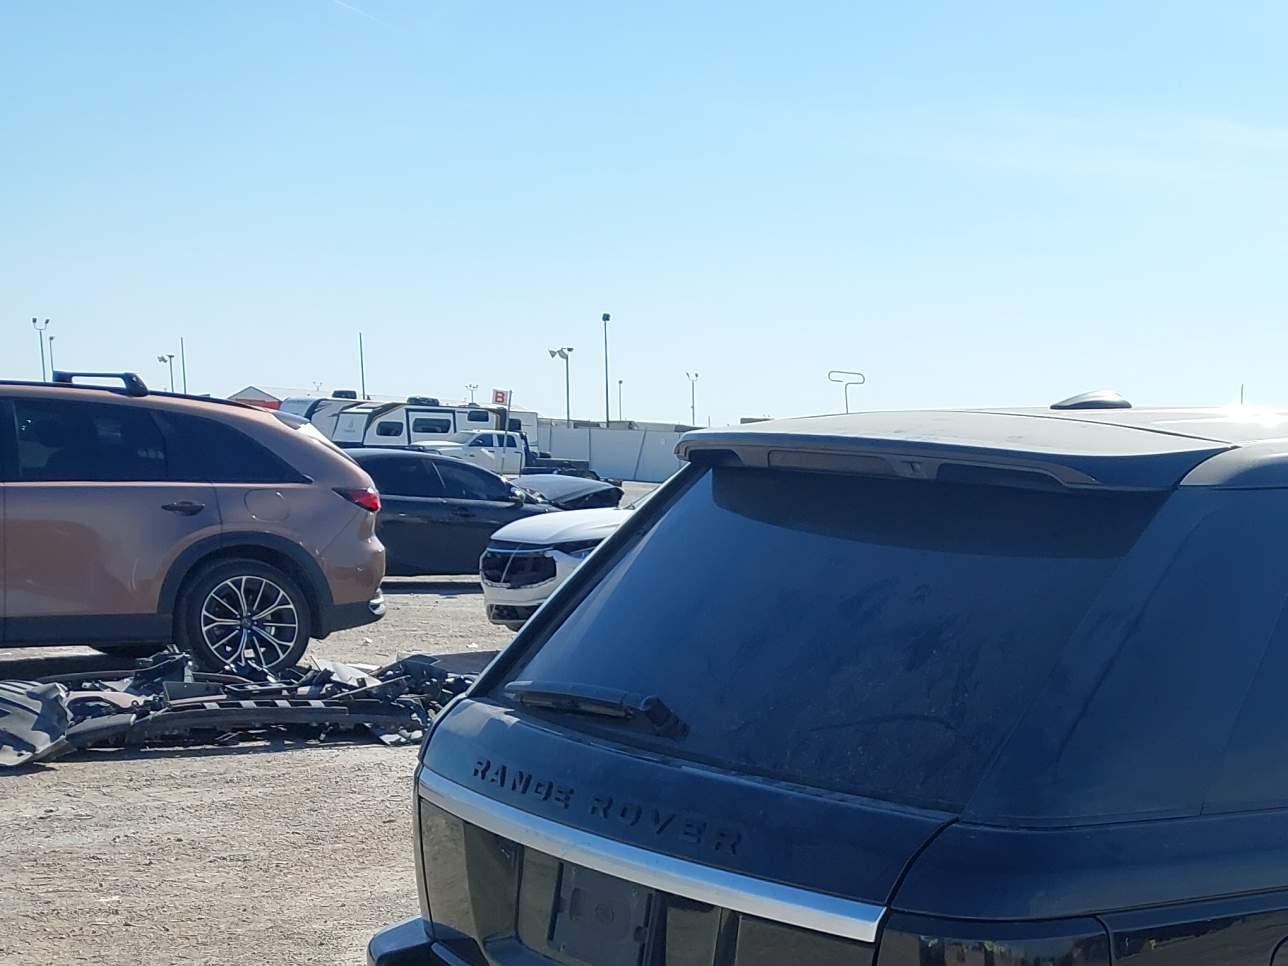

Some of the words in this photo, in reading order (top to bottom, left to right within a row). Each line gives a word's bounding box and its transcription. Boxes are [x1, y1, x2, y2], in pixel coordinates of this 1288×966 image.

[495, 391, 505, 403] B
[473, 759, 575, 810] RANGE
[590, 796, 743, 855] ROVER
